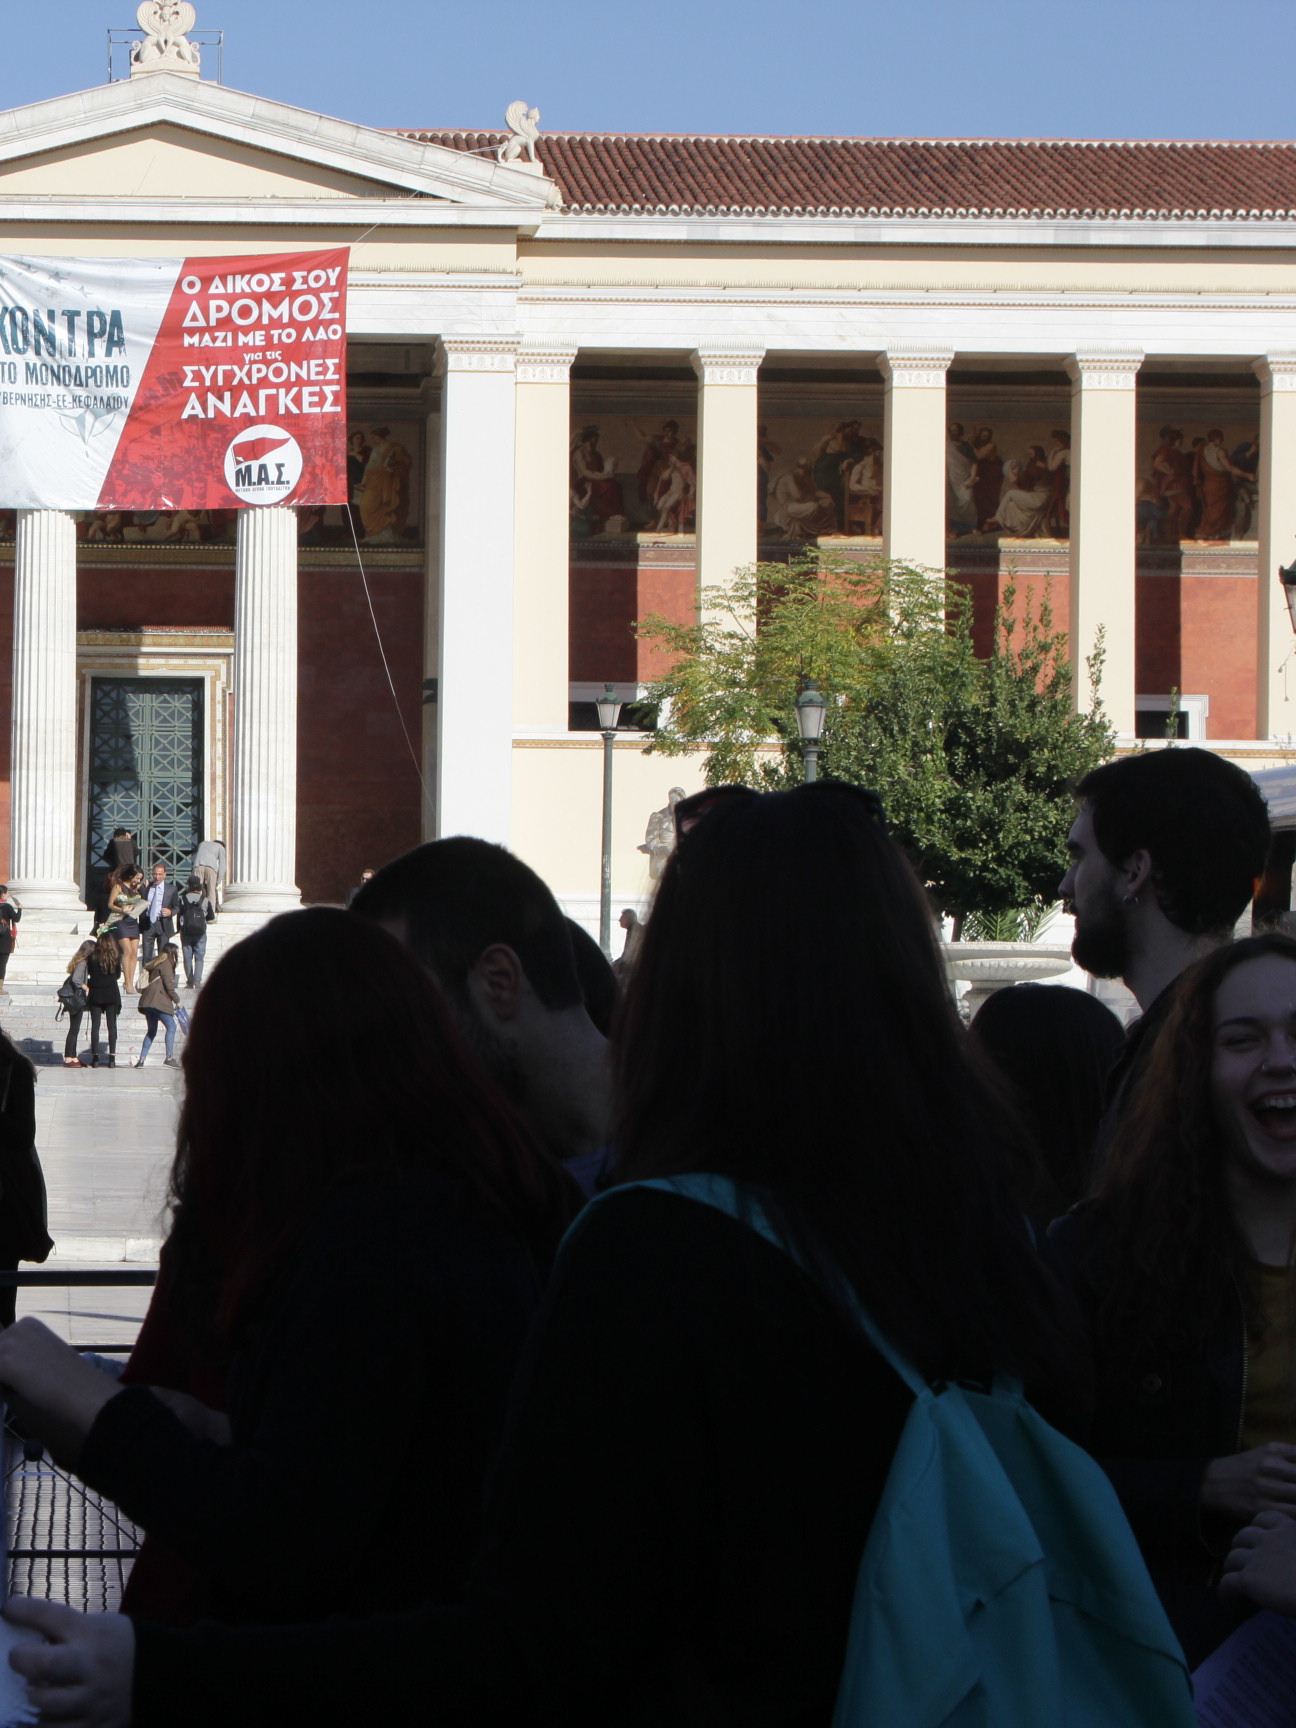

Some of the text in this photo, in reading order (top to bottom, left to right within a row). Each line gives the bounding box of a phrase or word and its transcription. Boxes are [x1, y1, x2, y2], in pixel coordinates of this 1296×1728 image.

[181, 266, 342, 295] Ο ΔΙΚΟΣ ΣΟΥ
[181, 291, 340, 328] ΔΡΟΜΟΣ
[183, 324, 342, 347] ΜΑΖΙ ΜΕ ΤΟ ΛΑΟ
[243, 350, 282, 364] για τις
[25, 362, 130, 388] ΜΟΝΟΔΡΟΜΟ
[181, 358, 340, 387] ΣΥΓΧΡΟΝΕΣ
[181, 385, 341, 419] ΑΝΑΓΚΕΣ
[235, 463, 290, 487] Μ.Α.Σ.
